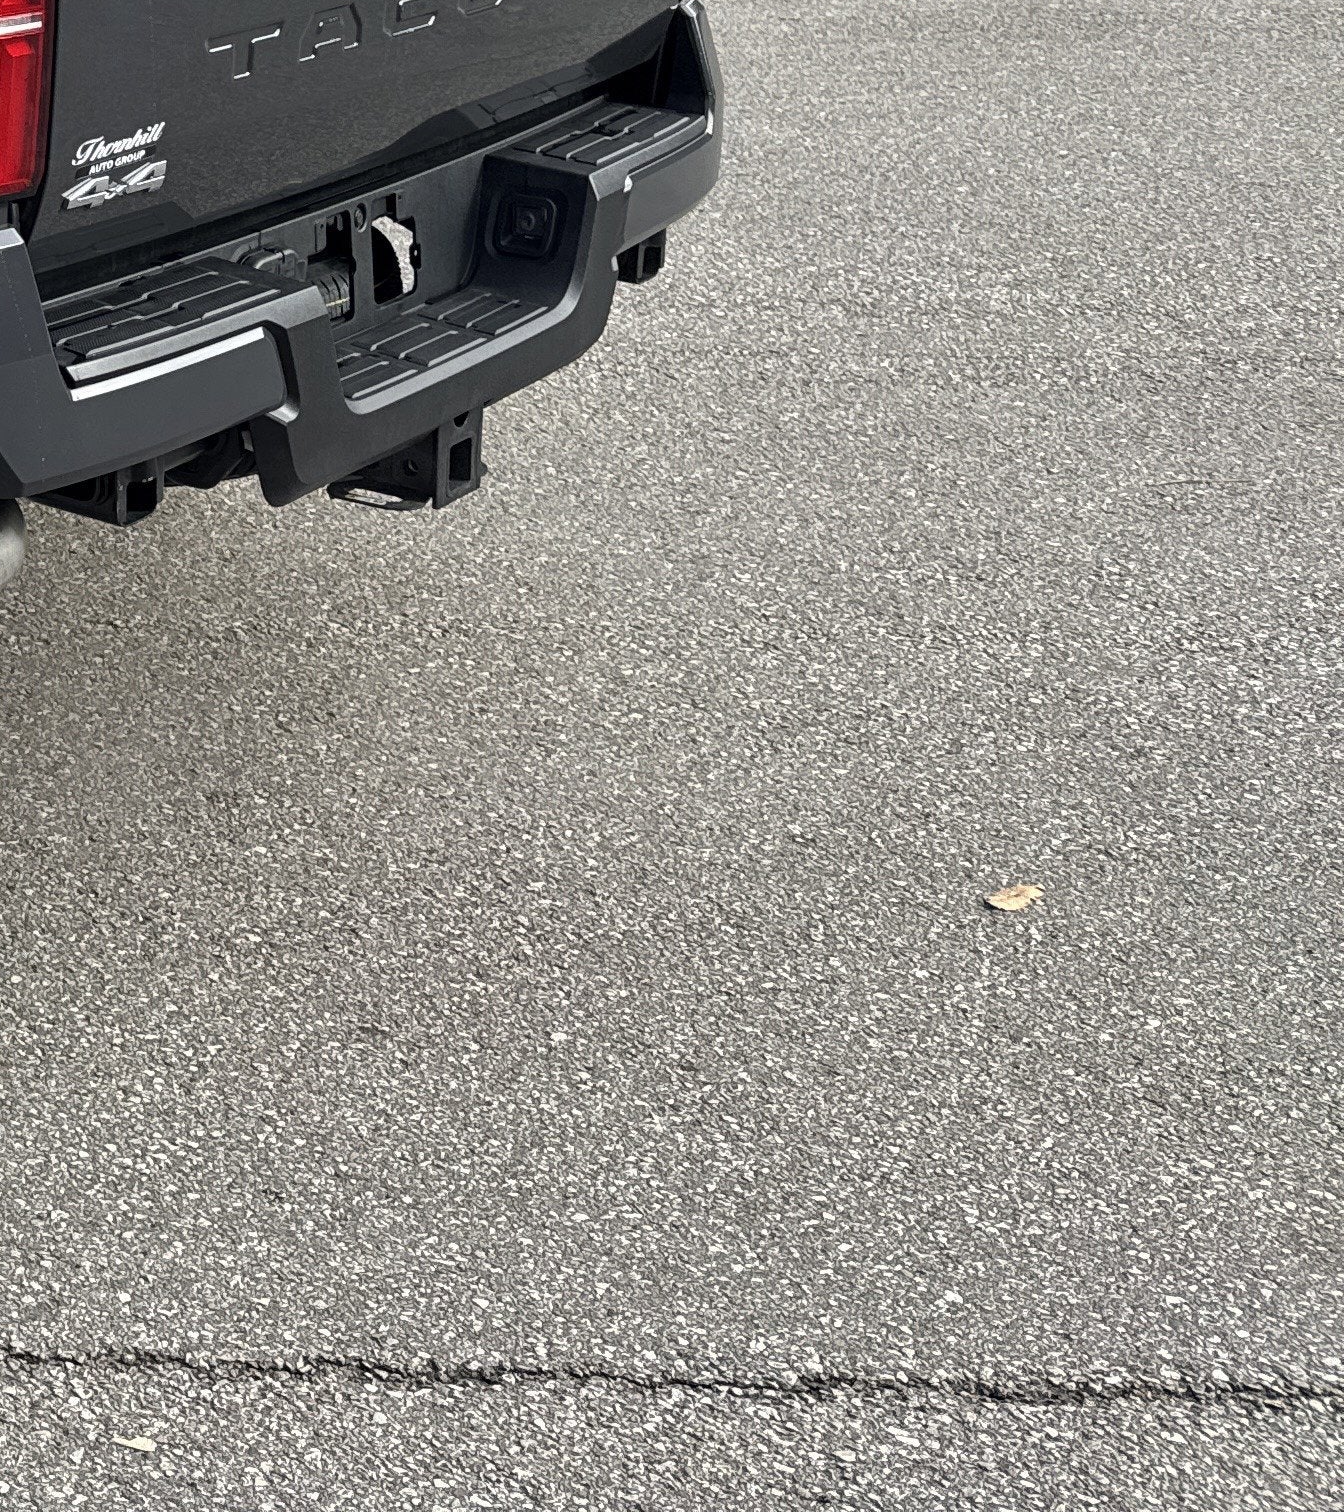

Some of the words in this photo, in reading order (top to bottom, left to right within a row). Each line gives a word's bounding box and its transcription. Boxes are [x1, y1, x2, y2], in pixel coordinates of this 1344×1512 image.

[72, 121, 166, 166] Thornhill
[89, 159, 114, 175] AUTO
[114, 149, 146, 167] GROUP
